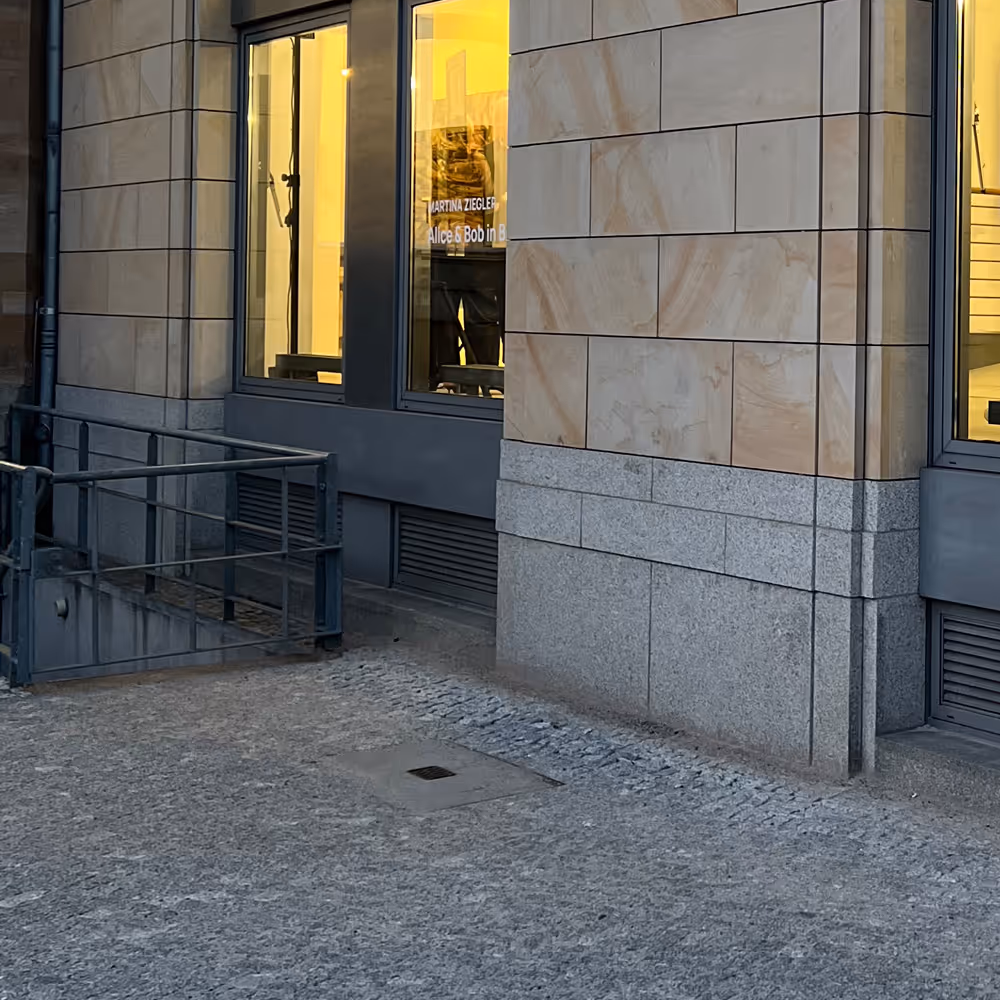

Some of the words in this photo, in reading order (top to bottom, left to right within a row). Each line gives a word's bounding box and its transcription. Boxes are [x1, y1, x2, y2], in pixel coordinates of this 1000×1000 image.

[428, 199, 463, 213] MARTINA
[428, 226, 453, 244] Alice
[455, 225, 462, 243] &
[464, 224, 485, 243] Bob
[486, 223, 497, 242] in
